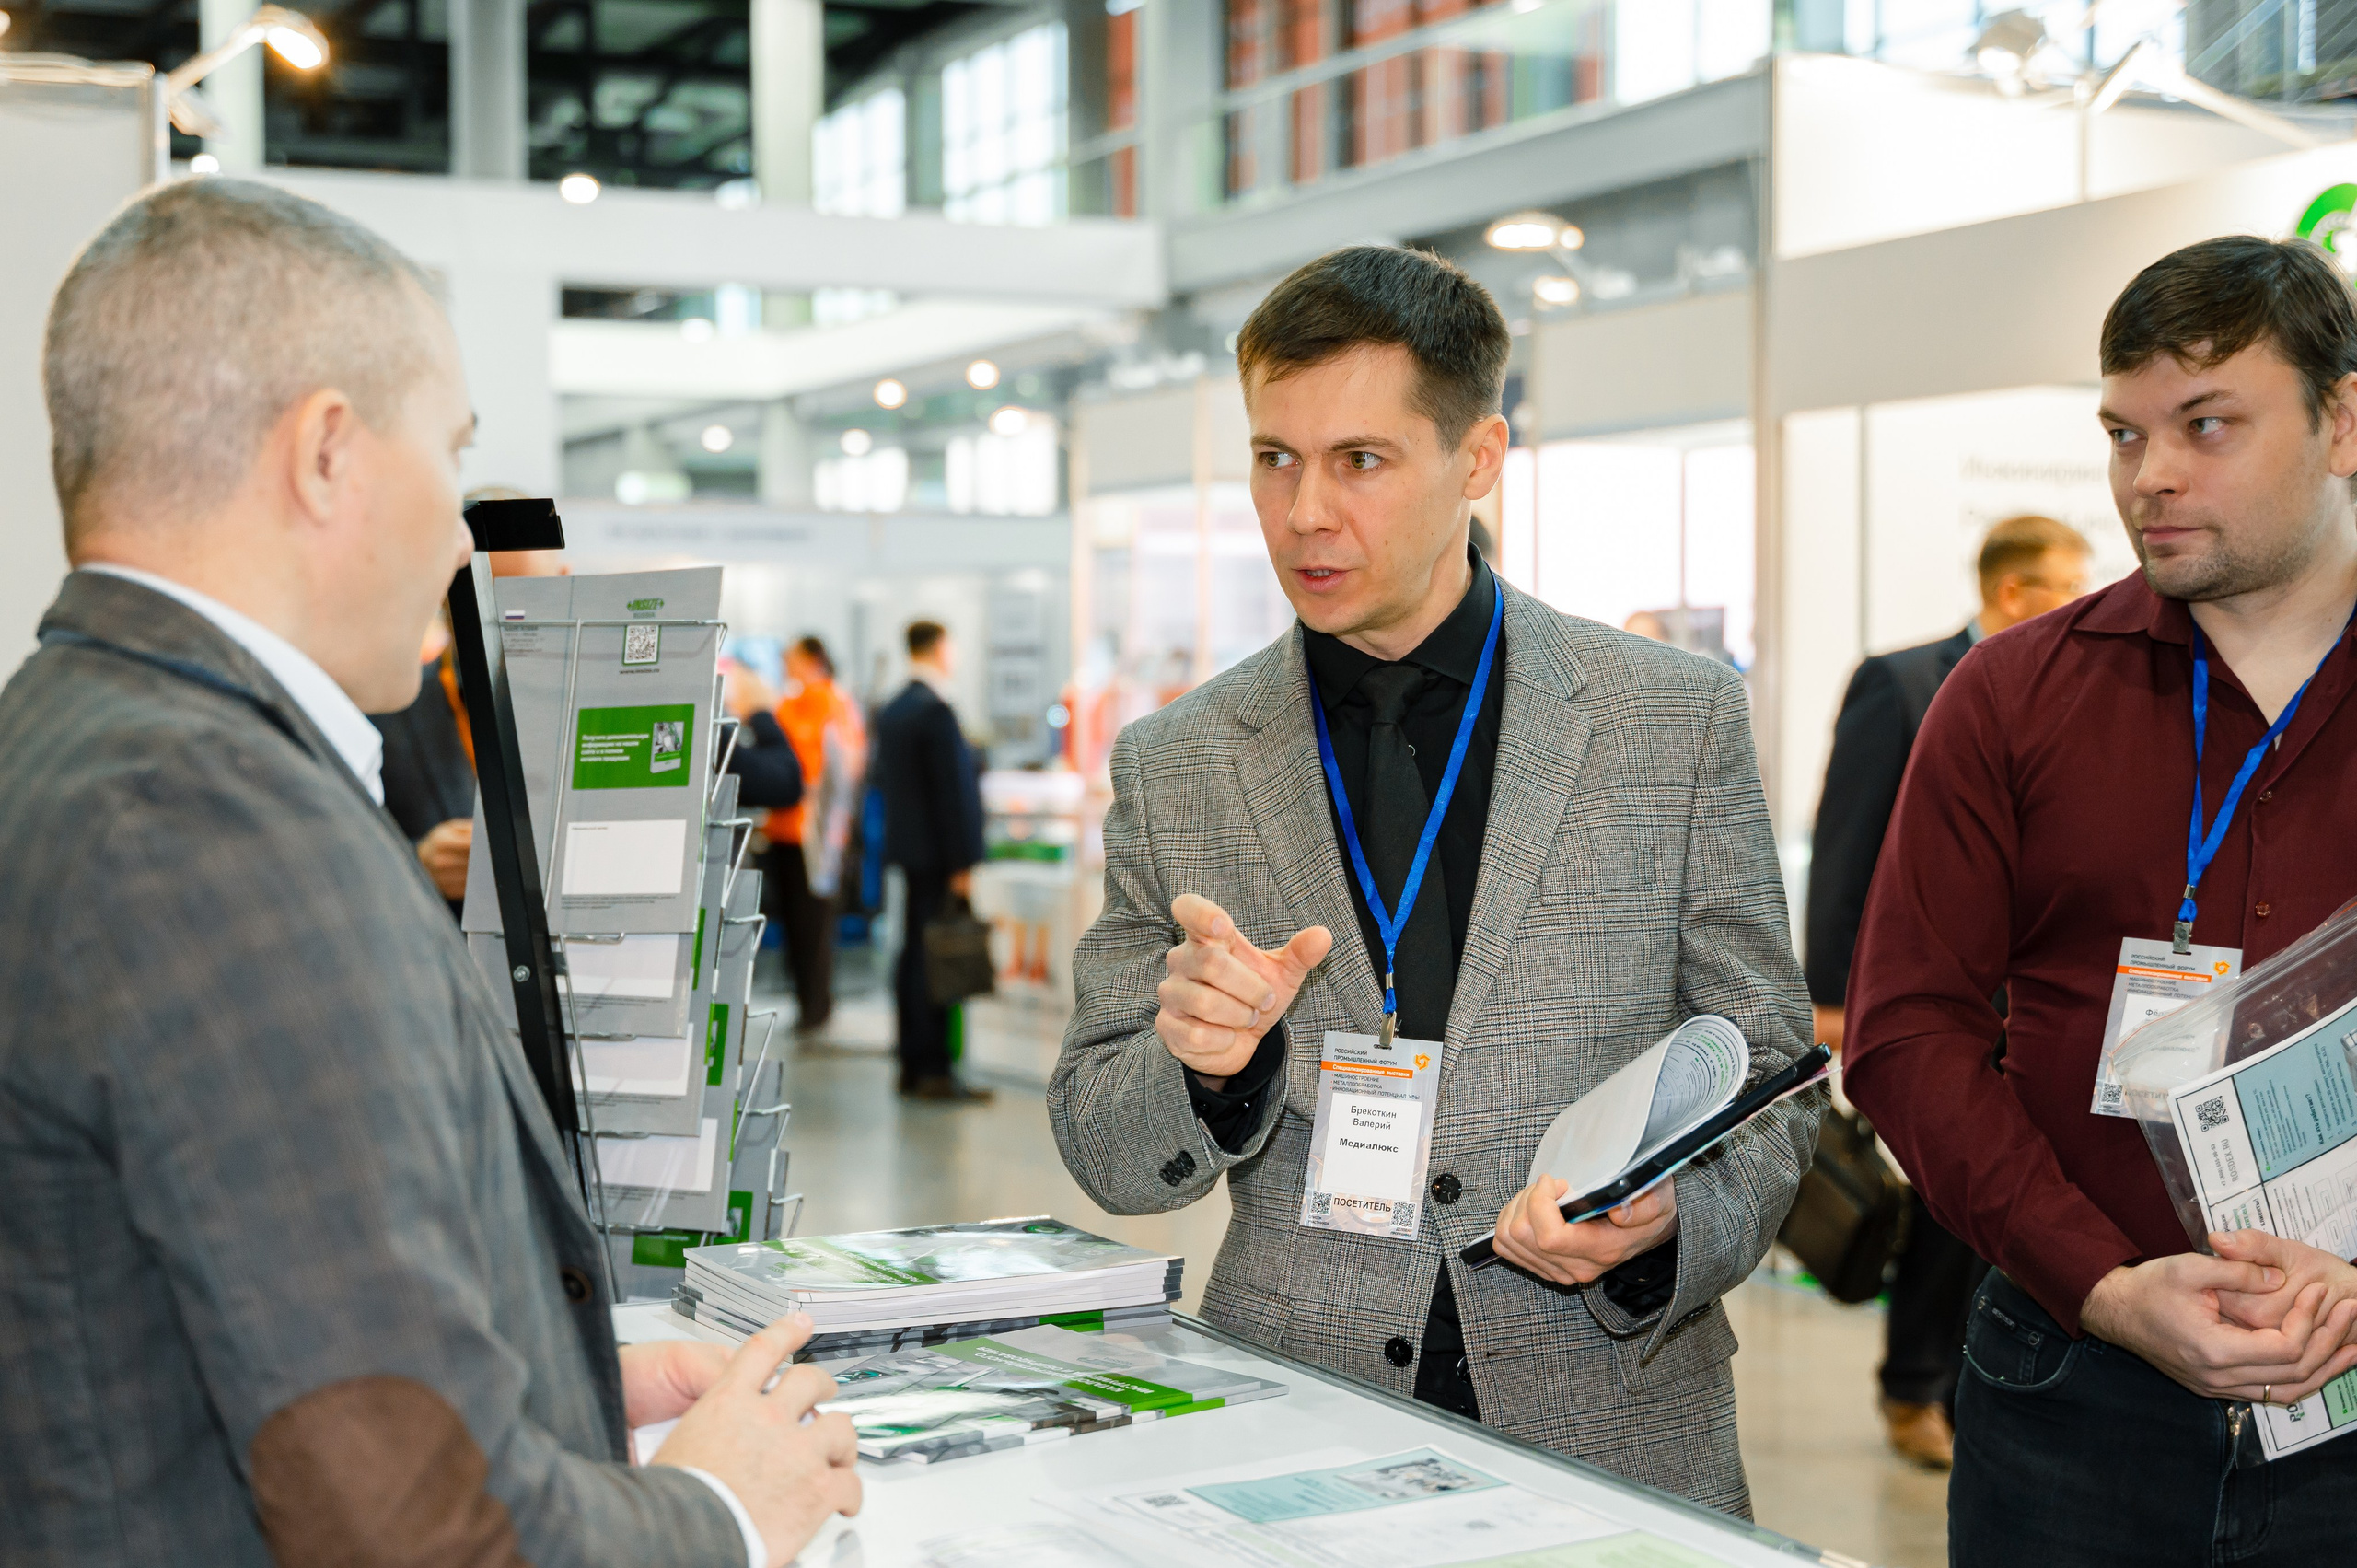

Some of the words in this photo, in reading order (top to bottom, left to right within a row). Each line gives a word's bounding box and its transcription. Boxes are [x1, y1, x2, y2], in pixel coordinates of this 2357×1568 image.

[1334, 1054, 1377, 1063] ПРОМЫШЛЕННЫЙ
[1334, 1074, 1379, 1082] МАШИНОСТРОЕНИЕ
[1332, 1086, 1376, 1095] ИННОВАЦИОННЫЙ
[1351, 1105, 1397, 1119] Брекоткин
[1353, 1118, 1391, 1130] Валерий
[1339, 1138, 1399, 1153] Медиалюкс
[2221, 1138, 2238, 1181] ROSDEX.RU
[1333, 1197, 1391, 1213] ПОСЕТИТЕЛЬ
